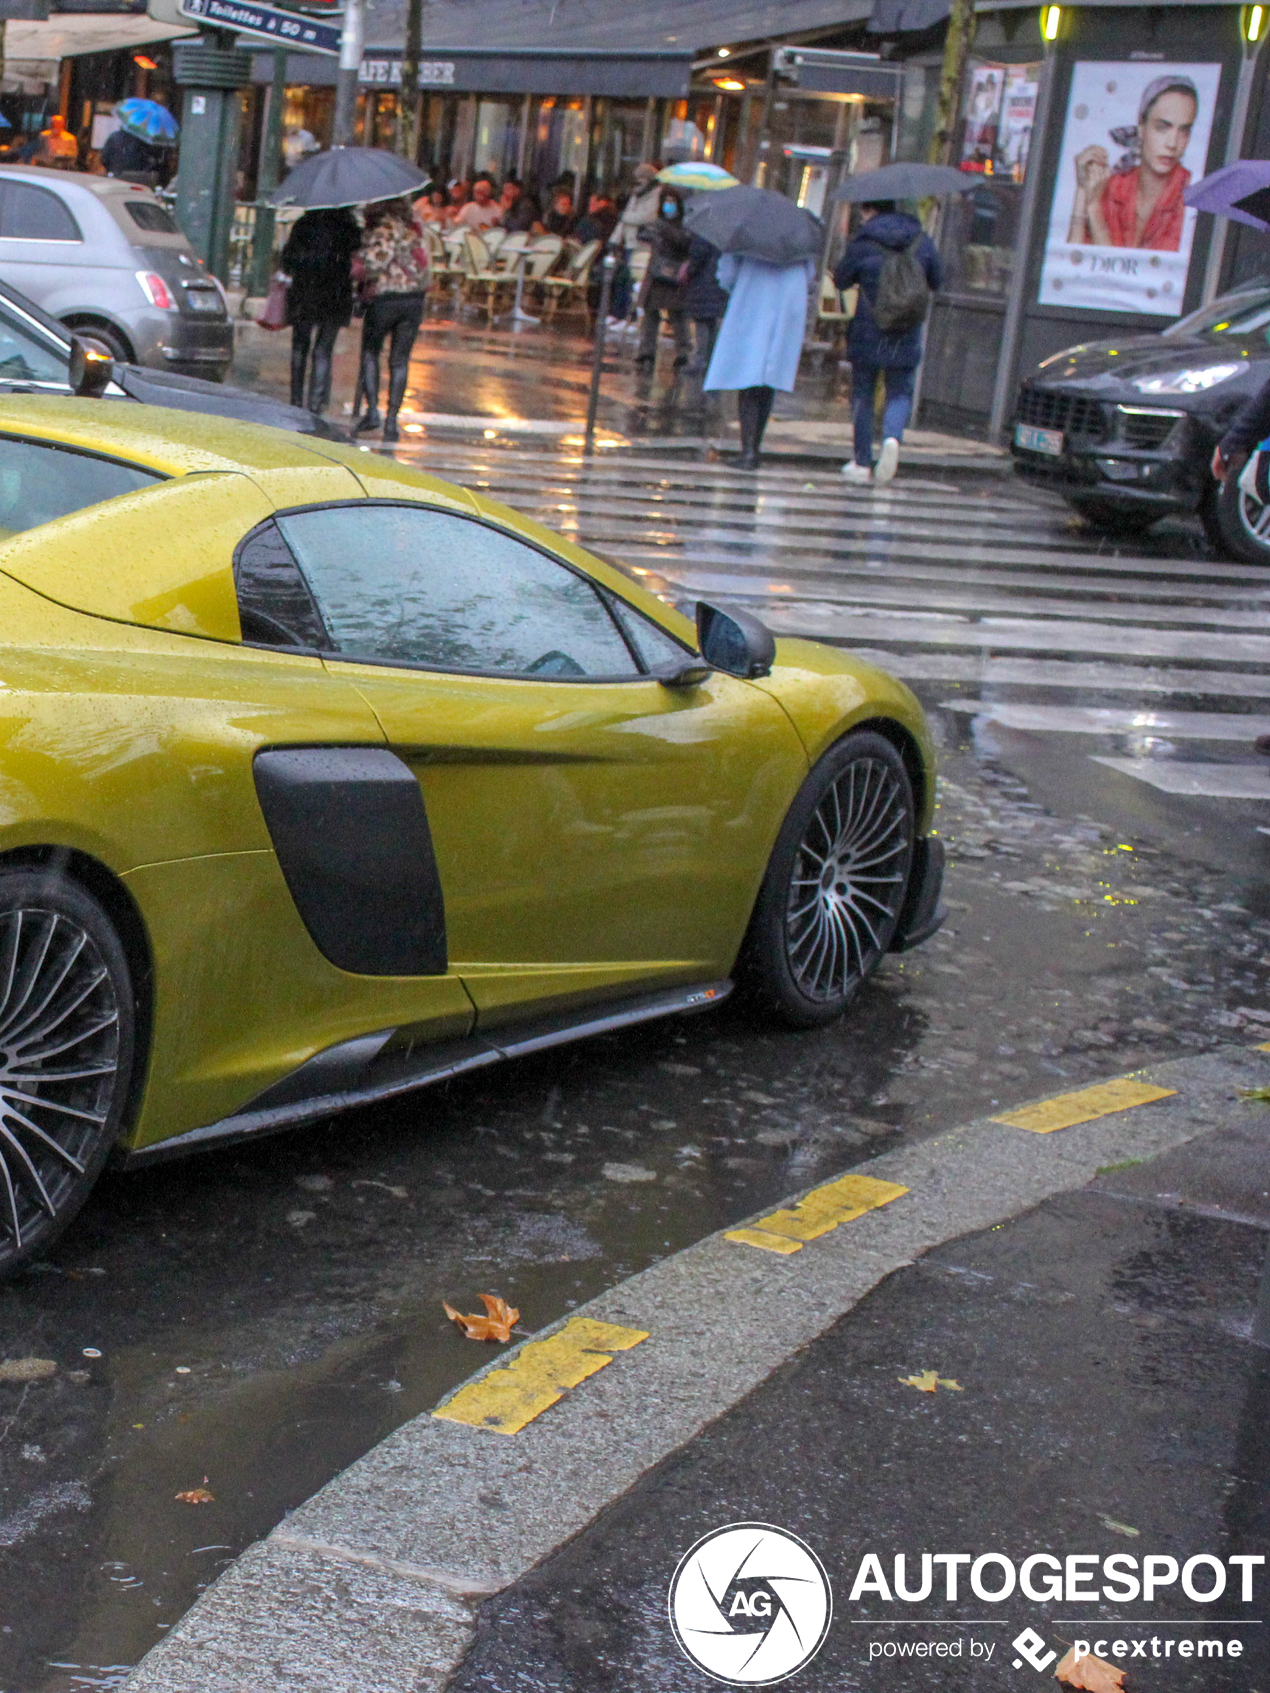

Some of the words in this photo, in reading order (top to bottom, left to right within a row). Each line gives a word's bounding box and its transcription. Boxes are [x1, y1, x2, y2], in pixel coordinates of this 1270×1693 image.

[210, 0, 263, 26] Toilettes
[280, 20, 301, 36] 50
[303, 29, 317, 41] m
[358, 60, 389, 82] AFE
[1090, 255, 1139, 276] DIOR
